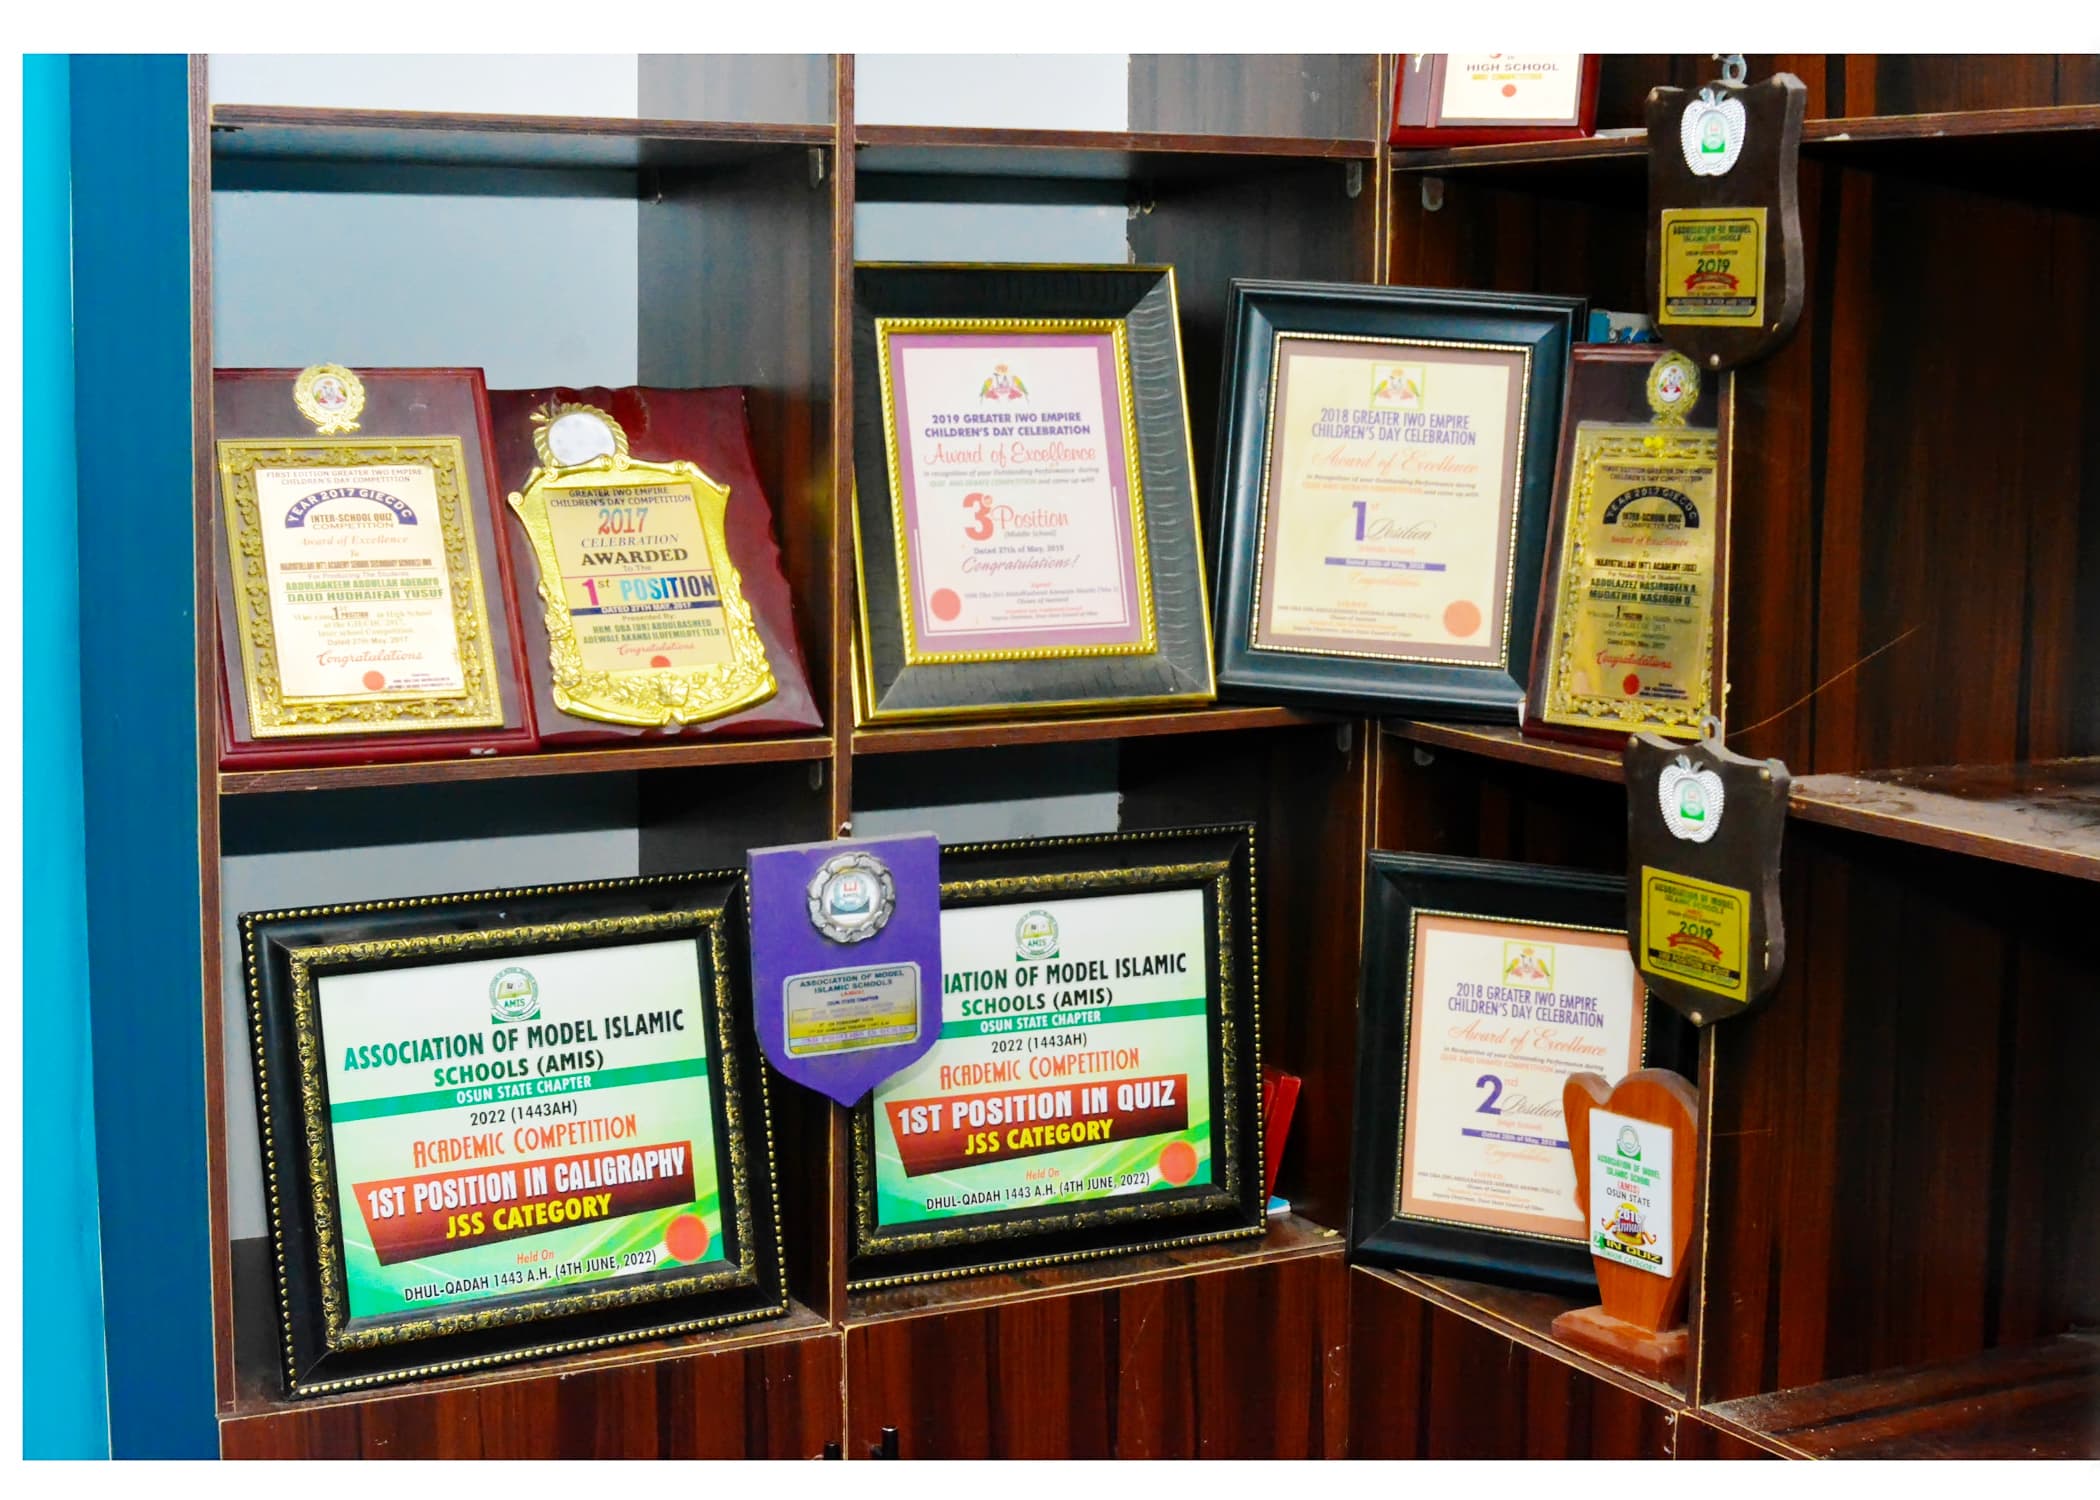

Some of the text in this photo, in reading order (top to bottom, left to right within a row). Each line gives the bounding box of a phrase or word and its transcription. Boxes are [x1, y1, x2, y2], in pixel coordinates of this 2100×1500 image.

[1466, 63, 1560, 72] HIGH SCHOOL
[1695, 258, 1731, 274] 2019
[931, 412, 1081, 425] 2019 GREATER IWO EMPIRE
[1321, 408, 1470, 430] 2018 GREATER IWO EMPIRE
[924, 425, 1091, 438] CHILDREN'S DAY CELEBRATION
[1311, 423, 1477, 446] CHILDREN'S DAY CELEBRATION
[923, 440, 1097, 468] Award of Excellence
[267, 470, 290, 478] FIRST
[293, 469, 330, 477] EDITION
[331, 468, 371, 477] GREATER
[392, 468, 423, 476] EMPIRE
[352, 474, 411, 484] COMPETITION
[551, 494, 692, 508] CHILDREN'S DAY COMPETITION
[569, 488, 610, 498] GREATER
[634, 486, 668, 496] EMPIRE
[287, 487, 414, 523] YEAR 2017 GIECDC
[1607, 491, 1633, 519] YEAR
[311, 512, 393, 524] INTER-SCHOOL QUIZ
[312, 521, 395, 531] COMPETITION
[598, 506, 650, 536] 2017
[991, 505, 1069, 529] Position
[1621, 521, 1682, 532] COMPETITION
[581, 533, 680, 549] CELEBRATION
[581, 547, 689, 567] AWARDED
[961, 554, 1081, 576] Congratulations!
[404, 588, 444, 600] YUSUF
[619, 575, 717, 602] POSITION
[601, 605, 629, 615] DATED
[316, 648, 425, 669] Congratulations
[1680, 920, 1713, 940] 2019
[1027, 939, 1048, 948] AMIS
[800, 969, 905, 988] ASSOCIATION OF MODEL
[944, 952, 1188, 995] IATION OF MODEL ISLAMIC
[814, 979, 893, 995] ISLAMIC SCHOOLS
[1456, 982, 1598, 1013] 2018 GREATER IWO EMPIRE
[504, 998, 526, 1008] AMIS
[961, 987, 1114, 1018] SCHOOLS (AMIS)
[1448, 997, 1605, 1029] CHILDREN'S DAY CELEBRATION
[980, 1010, 1102, 1034] OSUN STATE CHAPTER
[343, 1008, 685, 1072] ASSOCIATION OF MODEL ISLAMIC
[991, 1031, 1088, 1054] 2022 (1443AH)
[1448, 1018, 1509, 1045] Award
[1532, 1026, 1608, 1058] Excellence
[433, 1049, 604, 1088] SCHOOLS (AMIS)
[940, 1047, 1140, 1091] ACADEMIC COMPETITION
[456, 1075, 592, 1105] OSUN STATE CHAPTER
[470, 1099, 579, 1128] 2022 (1443AH)
[897, 1079, 1177, 1136] 1ST POSITION IN QUIZ
[413, 1113, 639, 1170] ACADEMIC COMPETITION
[964, 1118, 1115, 1156] JSS CATEGORY
[367, 1146, 687, 1221] 1ST POSITION IN CALIGRAPHY
[1025, 1167, 1061, 1182] Held On
[926, 1172, 1150, 1211] DHUL-QADAH 1443 A.H. (4TH JUNE, 2022)
[1606, 1187, 1651, 1208] OSUN STATE
[445, 1193, 613, 1241] JSS CATEGORY
[516, 1249, 555, 1265] Held On
[1606, 1240, 1622, 1250] IN
[1626, 1245, 1662, 1264] QUIZ
[404, 1249, 658, 1302] DHUL-QADAH 1443 A.H. (4TH JUNE, 2022)
